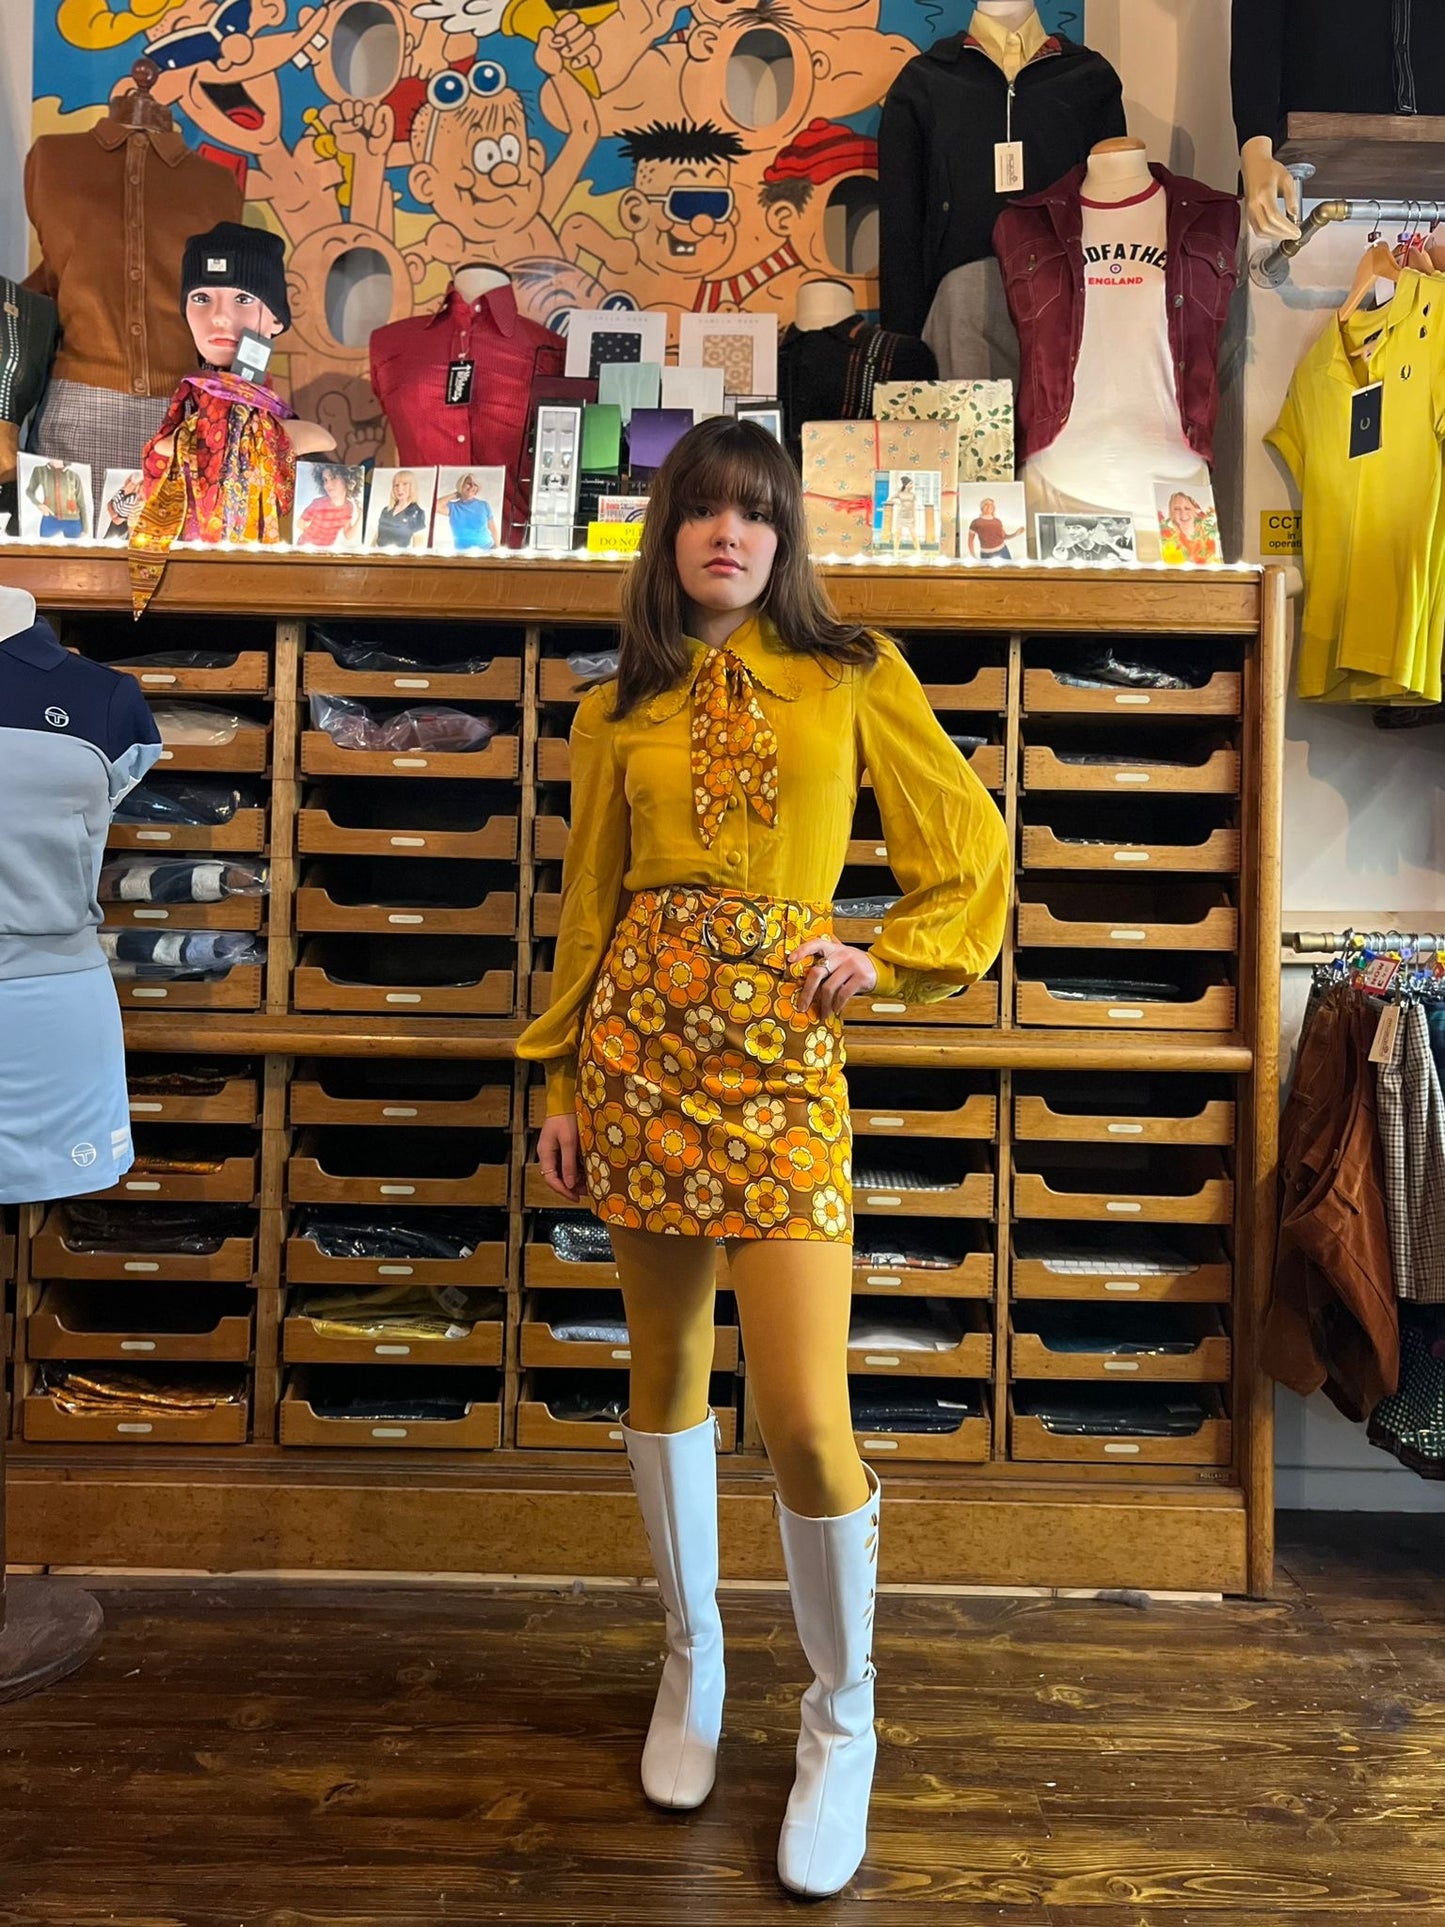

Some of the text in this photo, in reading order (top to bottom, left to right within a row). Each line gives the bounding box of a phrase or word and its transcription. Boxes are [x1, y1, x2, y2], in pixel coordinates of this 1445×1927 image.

[1083, 243, 1167, 271] DFATHE
[1088, 276, 1144, 285] ENGLAND
[1269, 516, 1302, 529] CCT
[600, 537, 640, 546] DO NO
